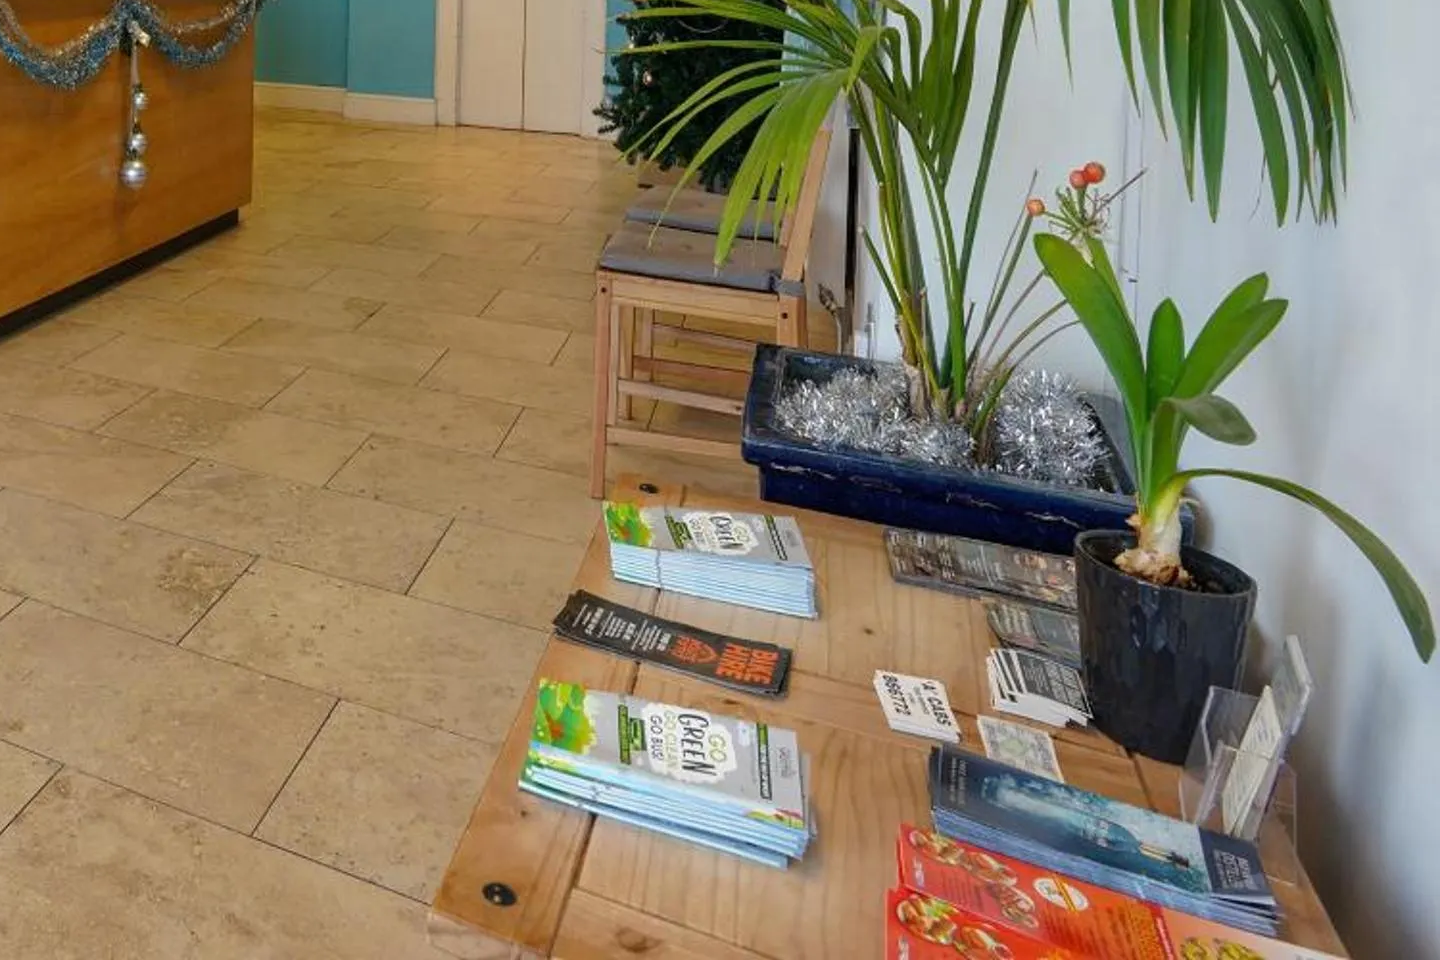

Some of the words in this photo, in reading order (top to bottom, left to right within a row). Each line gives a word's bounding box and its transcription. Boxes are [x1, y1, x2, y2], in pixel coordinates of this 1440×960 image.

[710, 515, 744, 549] GREEN
[715, 642, 750, 680] HIRE
[743, 648, 779, 684] BIKE
[649, 715, 663, 735] GO
[664, 709, 677, 731] GO
[927, 696, 952, 727] CABS
[678, 713, 718, 777] GREEN
[709, 734, 727, 763] GO
